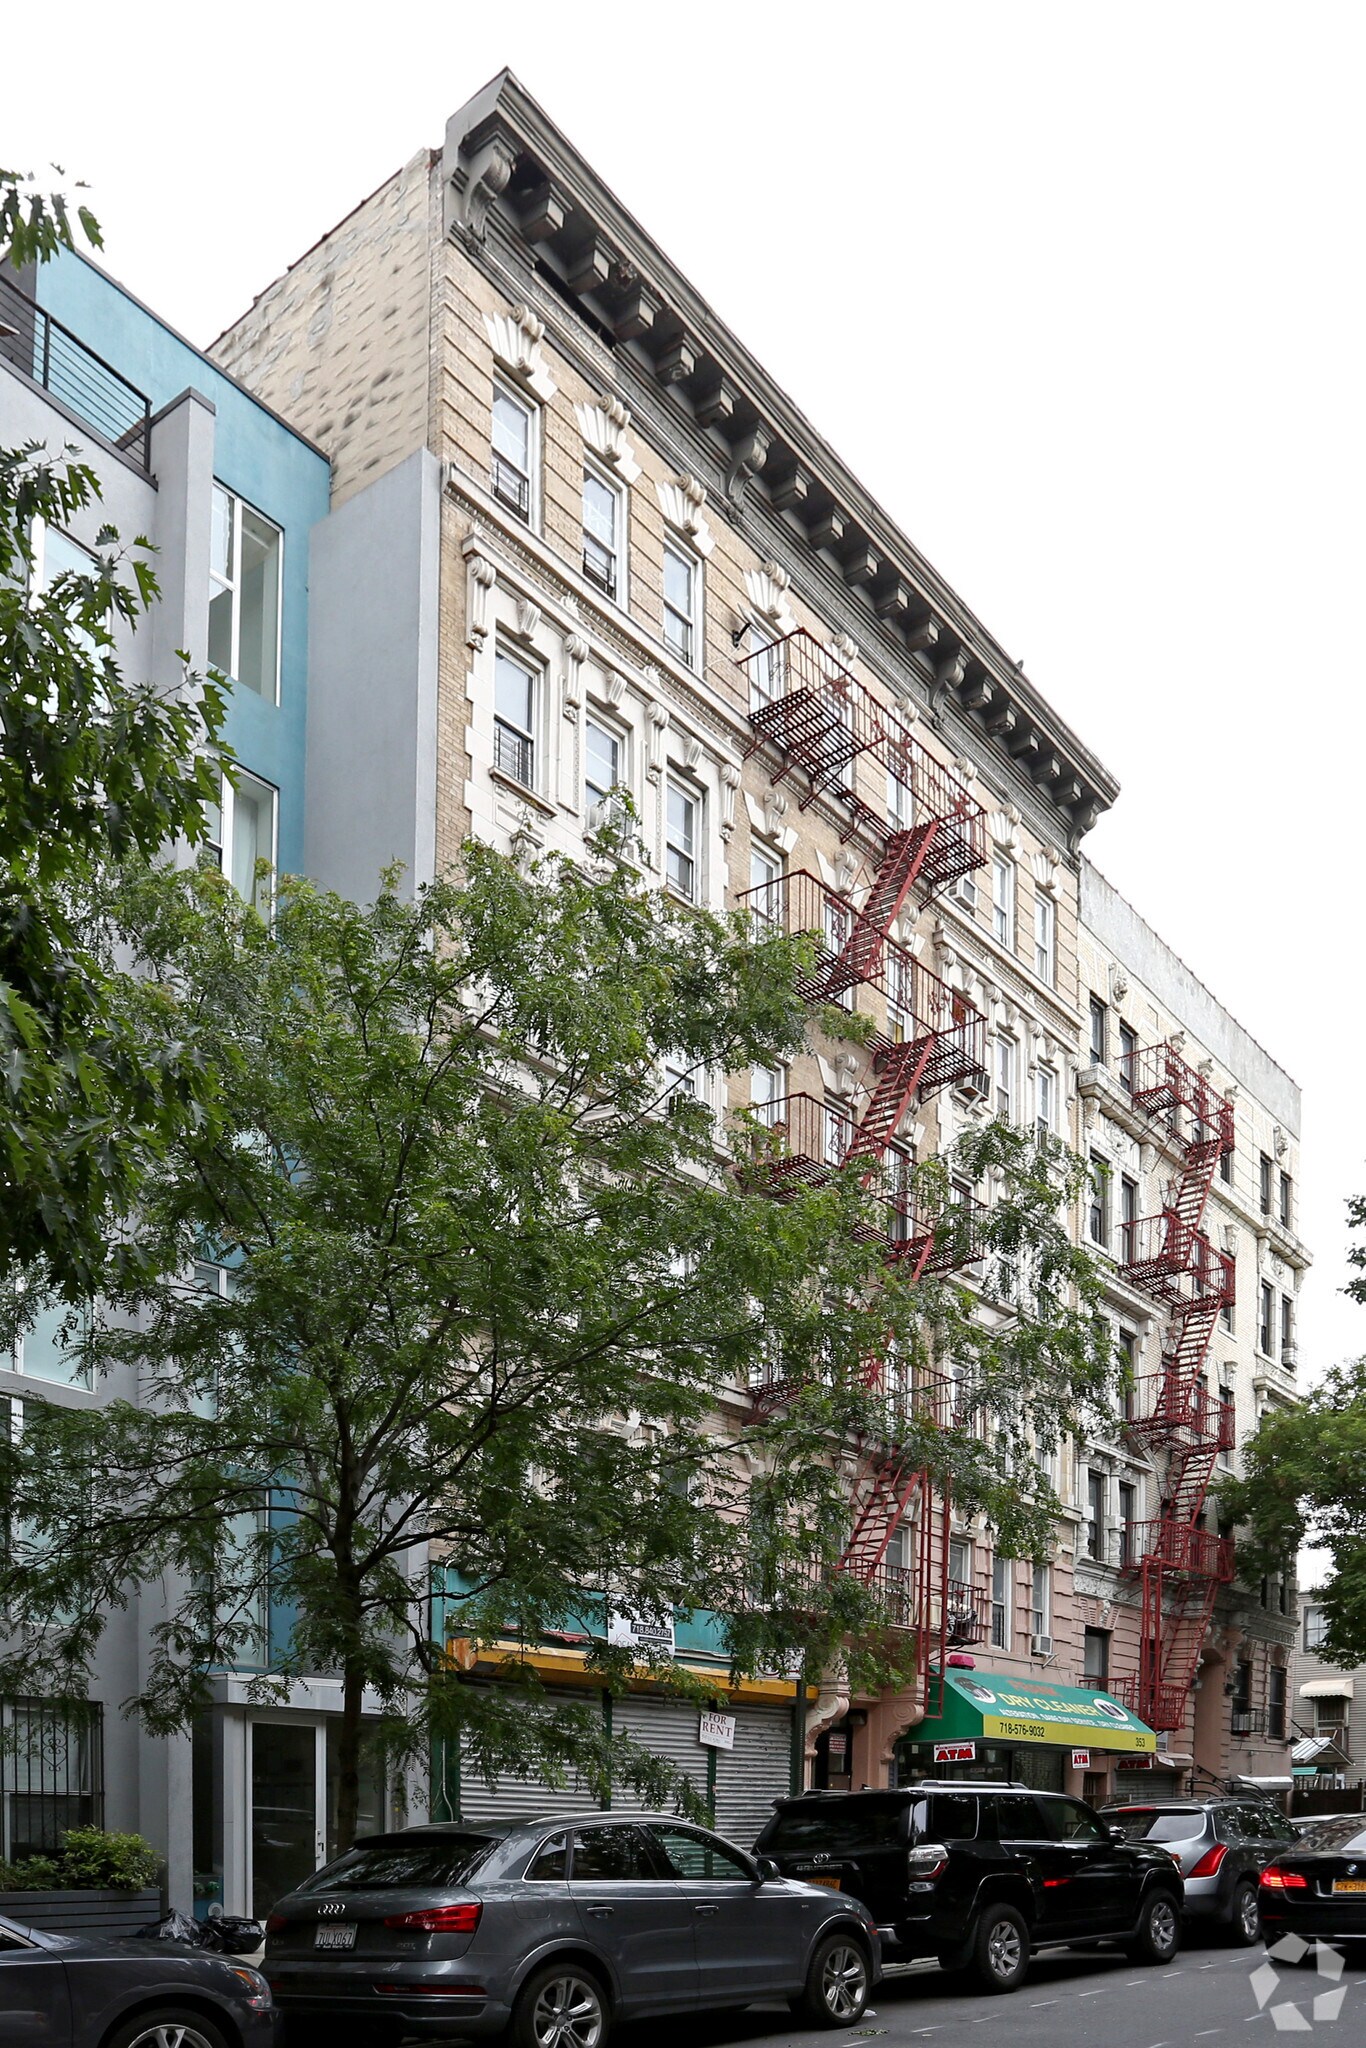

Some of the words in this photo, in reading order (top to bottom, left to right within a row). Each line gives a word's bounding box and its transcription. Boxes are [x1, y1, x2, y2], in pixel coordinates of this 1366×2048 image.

[632, 1624, 671, 1637] 718.840.2757
[997, 1692, 1035, 1708] DRY
[1032, 1698, 1104, 1717] CLEANER
[708, 1713, 727, 1725] FOR
[702, 1721, 733, 1737] RENT
[1000, 1722, 1045, 1738] 718-576-9032
[1135, 1737, 1146, 1748] 353
[936, 1748, 973, 1761] ATM
[1074, 1754, 1089, 1764] ATM
[1117, 1760, 1151, 1769] ATM
